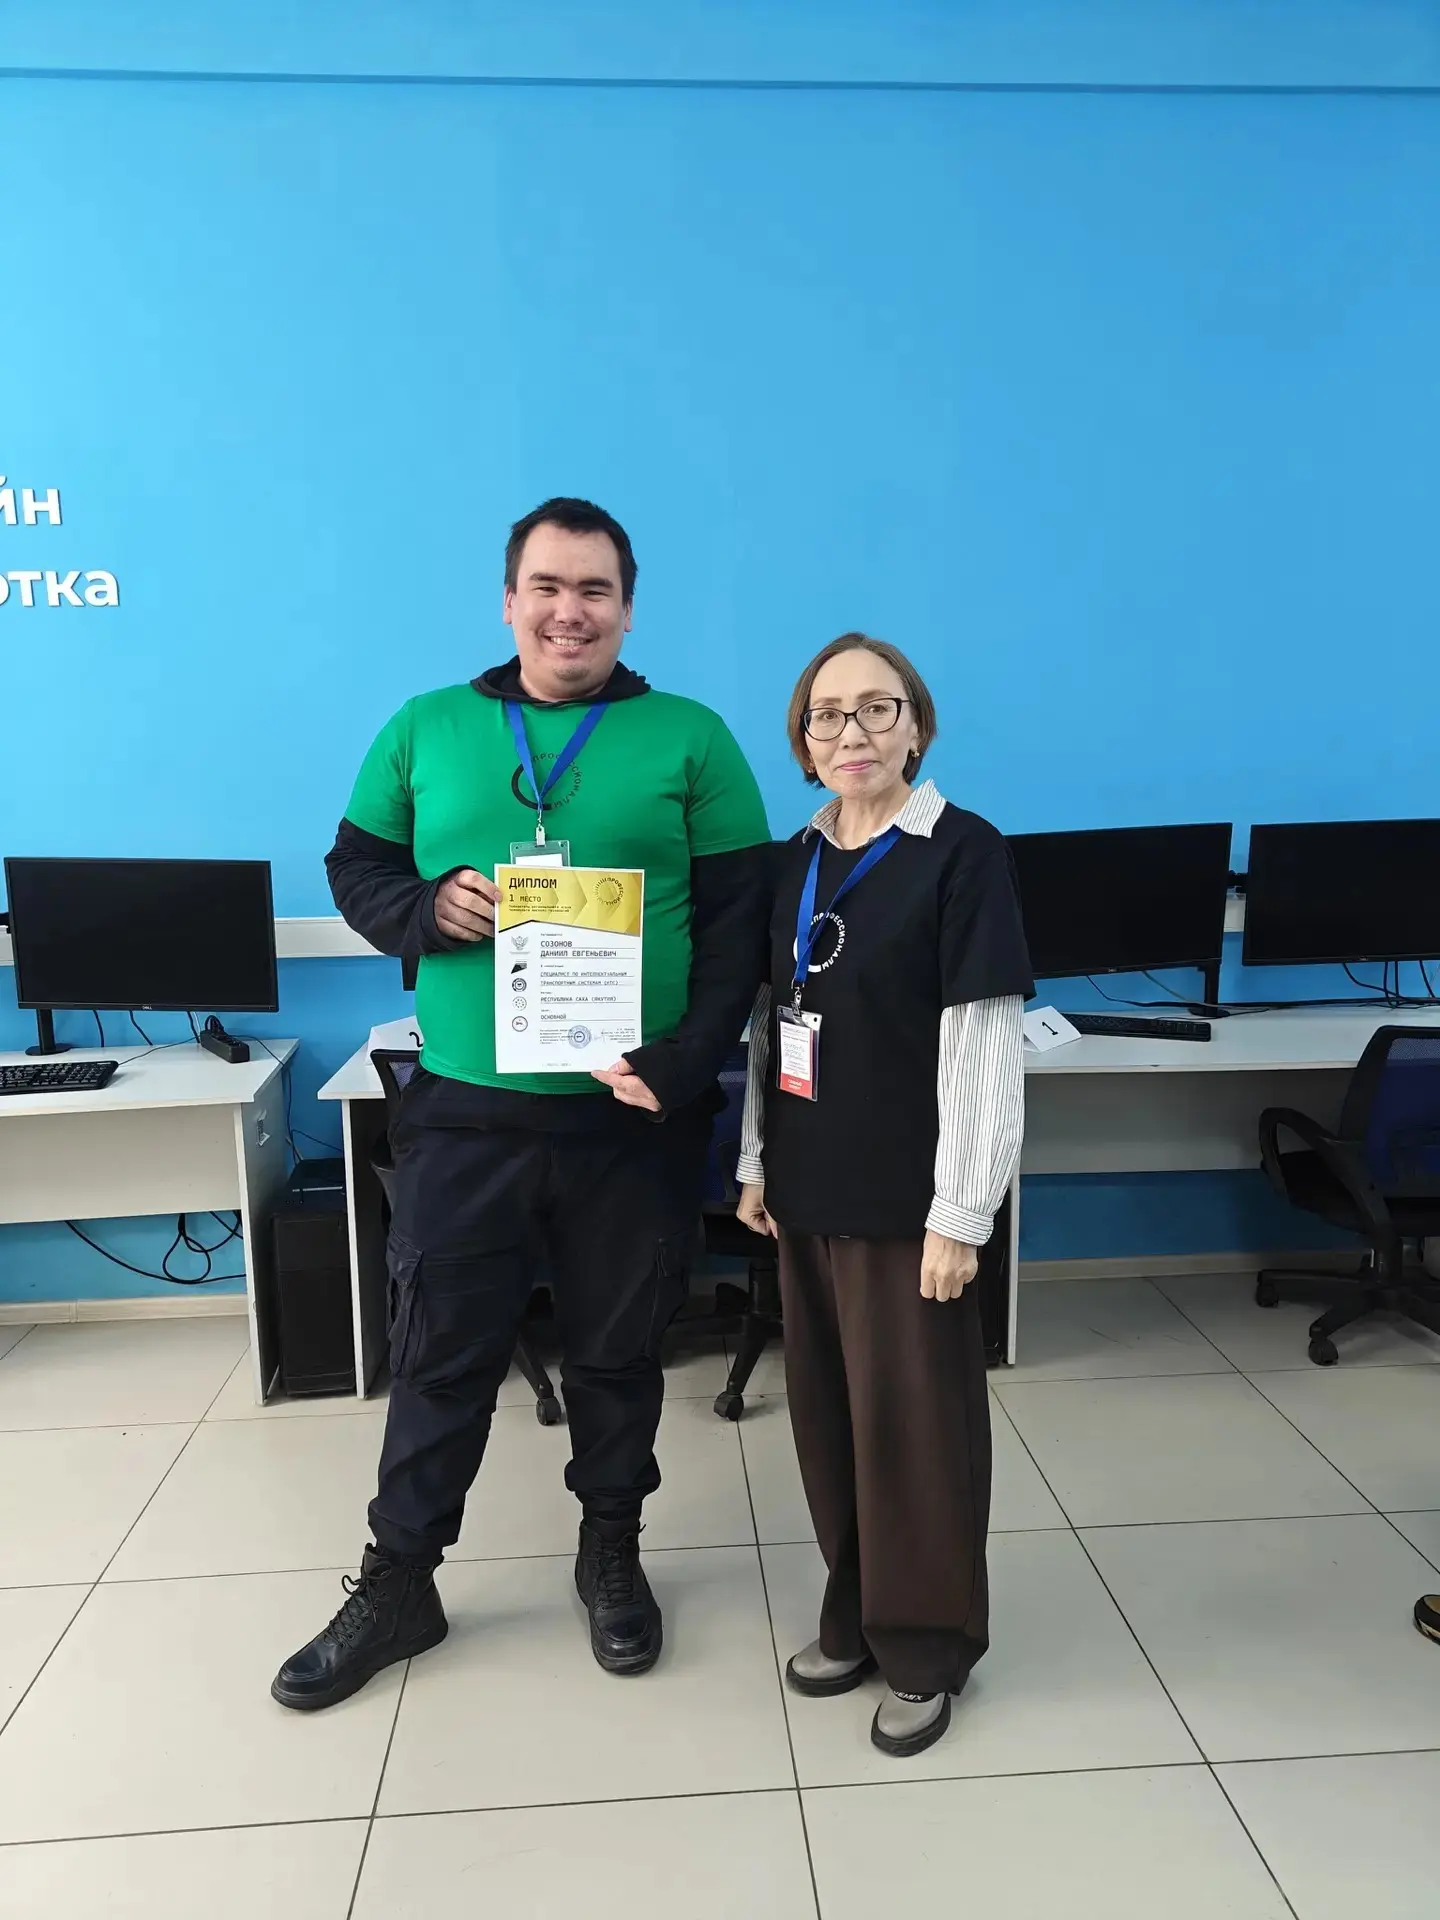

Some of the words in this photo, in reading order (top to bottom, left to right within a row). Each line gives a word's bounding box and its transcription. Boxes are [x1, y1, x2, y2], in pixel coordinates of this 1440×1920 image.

[0, 569, 120, 607] тка
[532, 752, 582, 808] ПРОСИОНАЛЫ
[508, 877, 557, 890] ДИПЛОМ
[509, 894, 514, 902] 1
[520, 895, 542, 903] МЕСТО
[540, 940, 573, 948] СОЗОНОВ
[540, 950, 568, 958] ДАНИИЛ
[1042, 1021, 1058, 1036] 1
